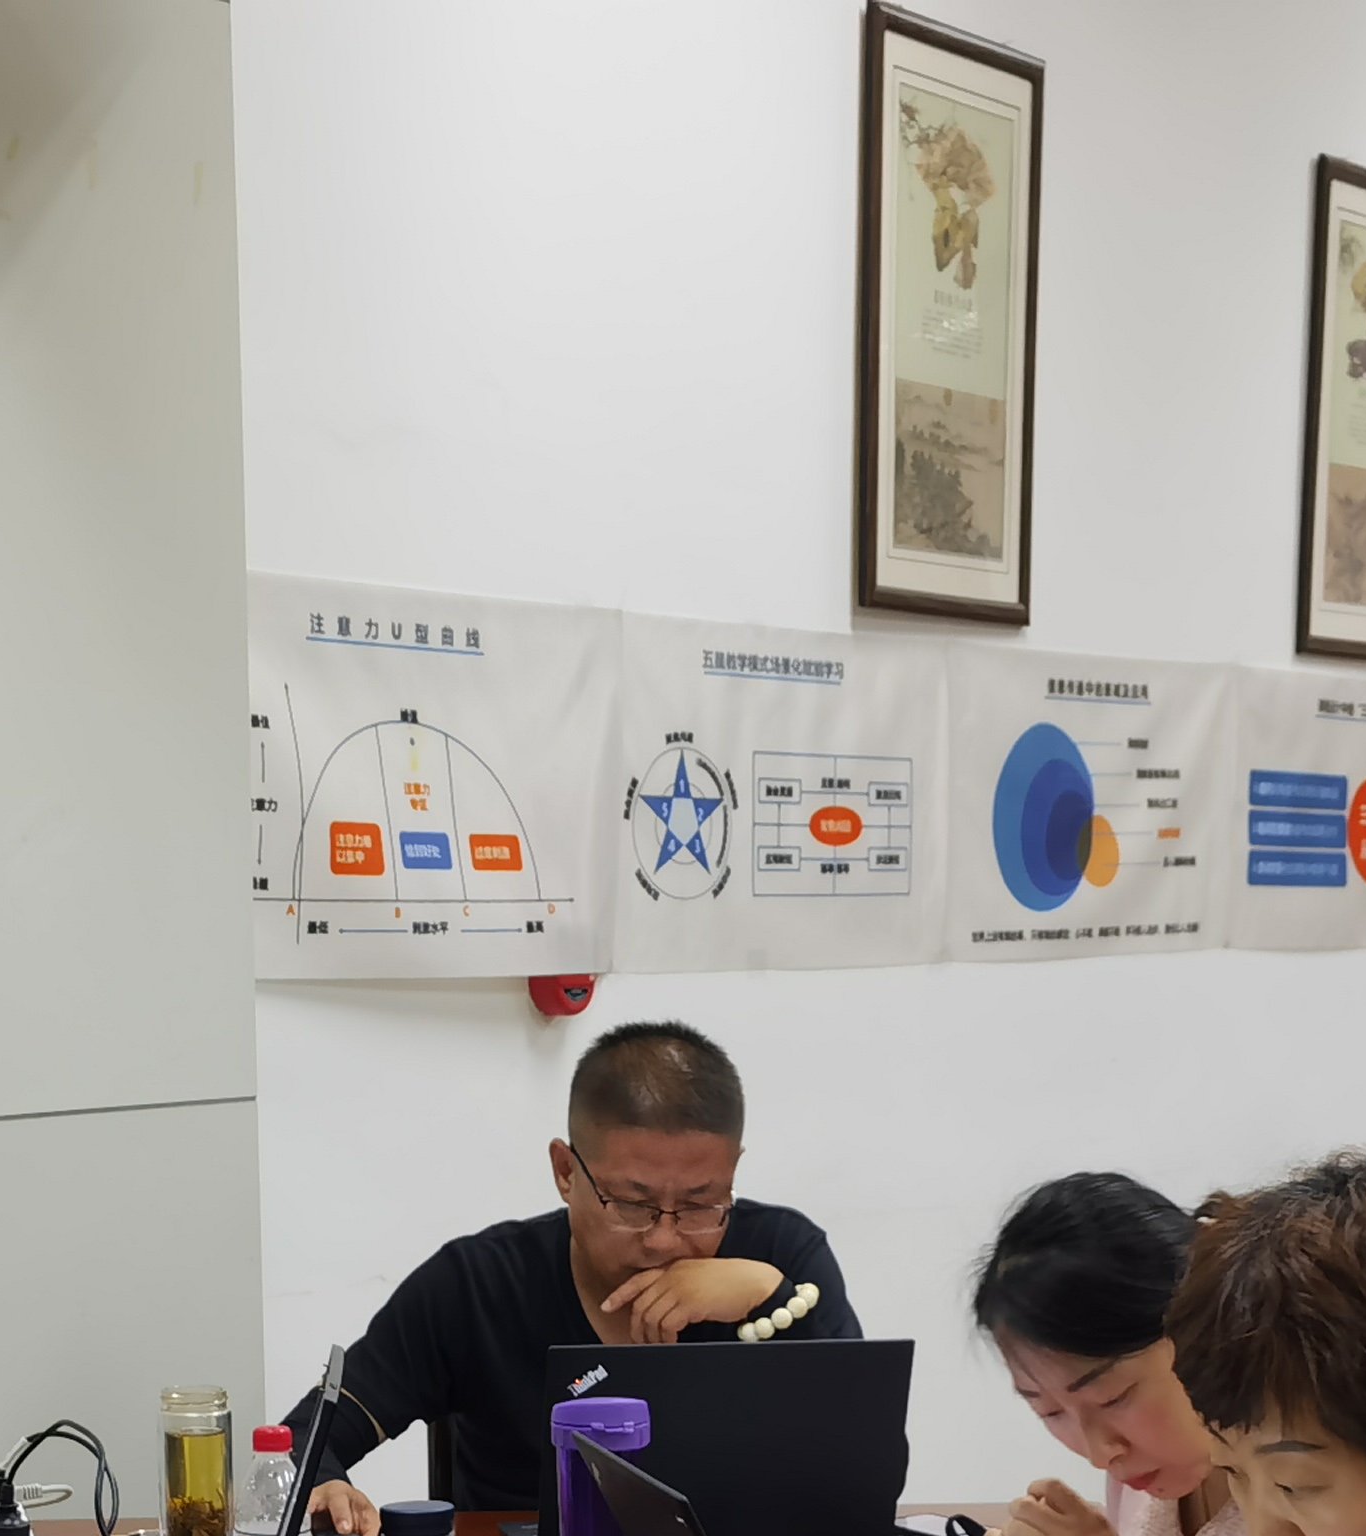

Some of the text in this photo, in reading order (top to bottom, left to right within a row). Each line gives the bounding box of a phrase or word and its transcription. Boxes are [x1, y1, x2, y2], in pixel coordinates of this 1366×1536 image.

[309, 612, 481, 649] 注意力U型曲线
[286, 904, 296, 917] A
[394, 907, 401, 918] B
[463, 905, 471, 917] C
[547, 903, 556, 915] D
